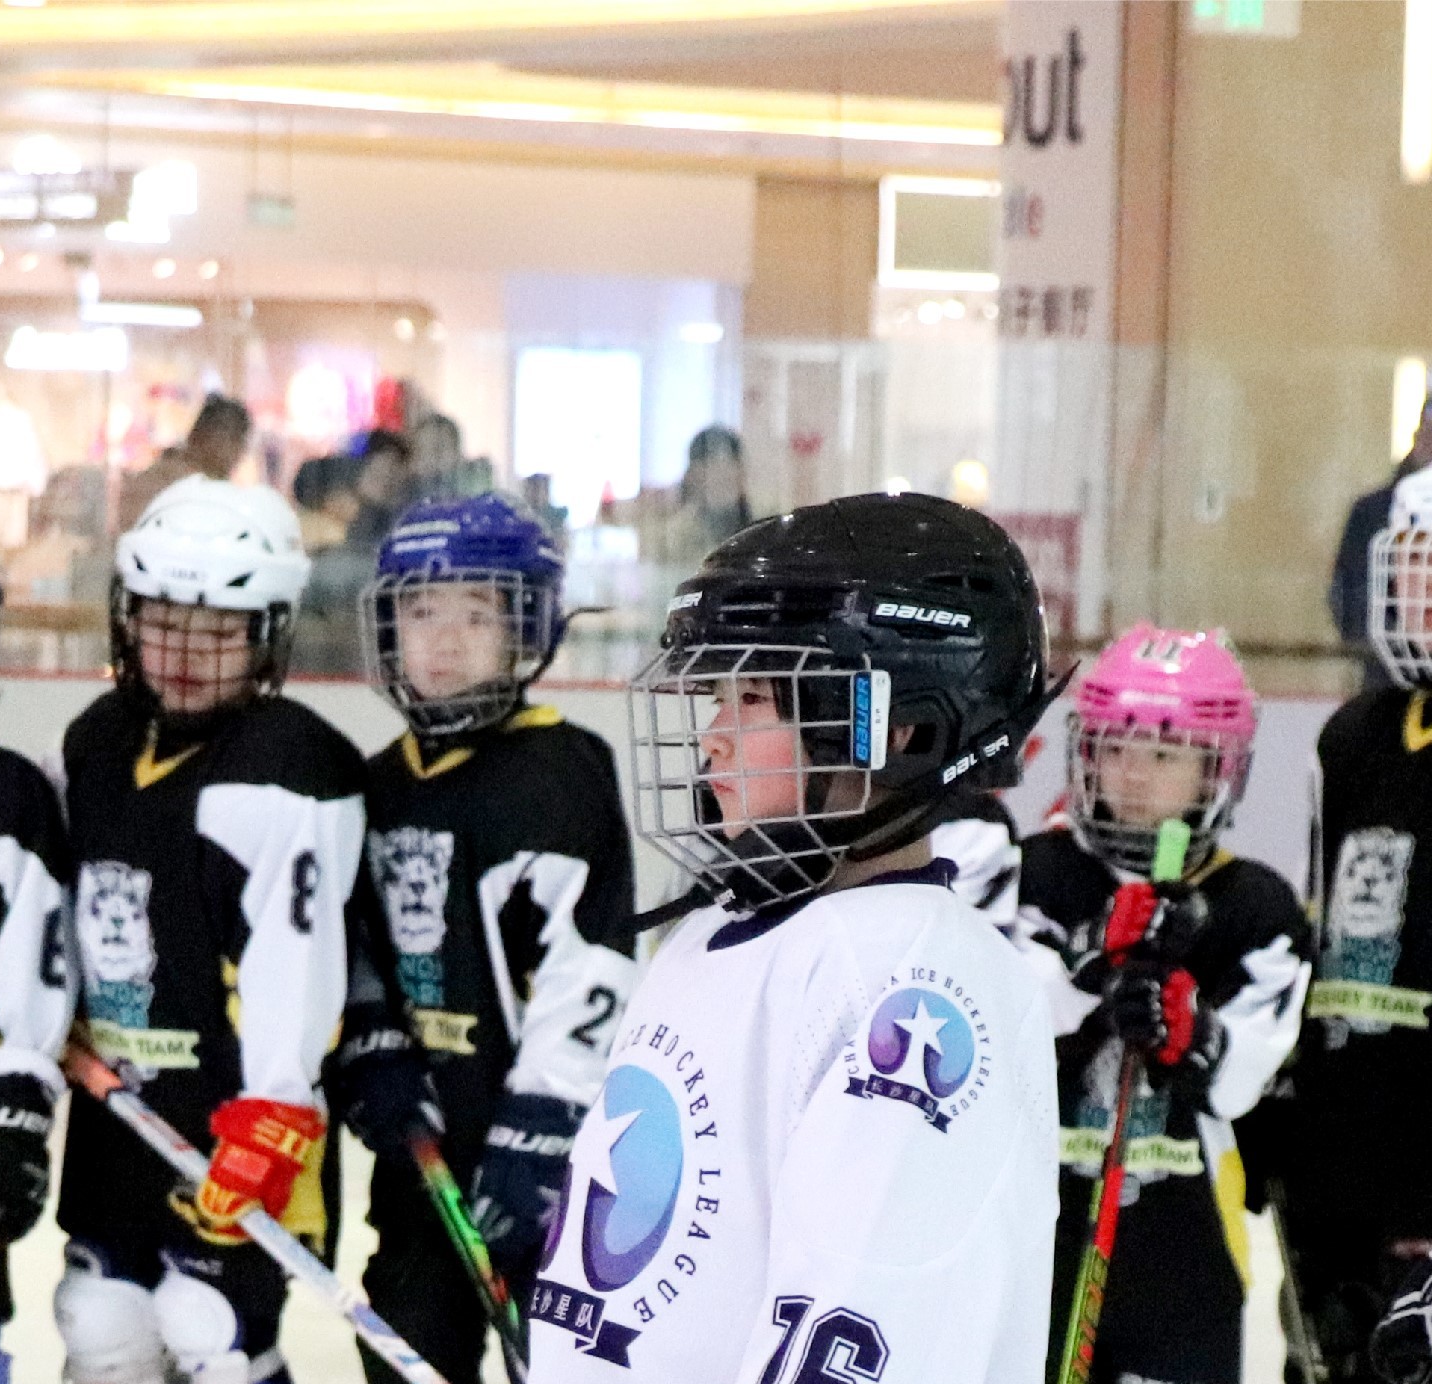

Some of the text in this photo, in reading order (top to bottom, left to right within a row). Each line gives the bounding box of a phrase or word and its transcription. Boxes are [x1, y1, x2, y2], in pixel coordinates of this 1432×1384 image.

[875, 603, 972, 628] BAUER
[855, 676, 870, 762] BAUER
[911, 967, 937, 983] ICE
[943, 976, 990, 1044] HOCKEY
[649, 1023, 718, 1140] HOCKEY
[633, 1168, 721, 1324] LEAGUE
